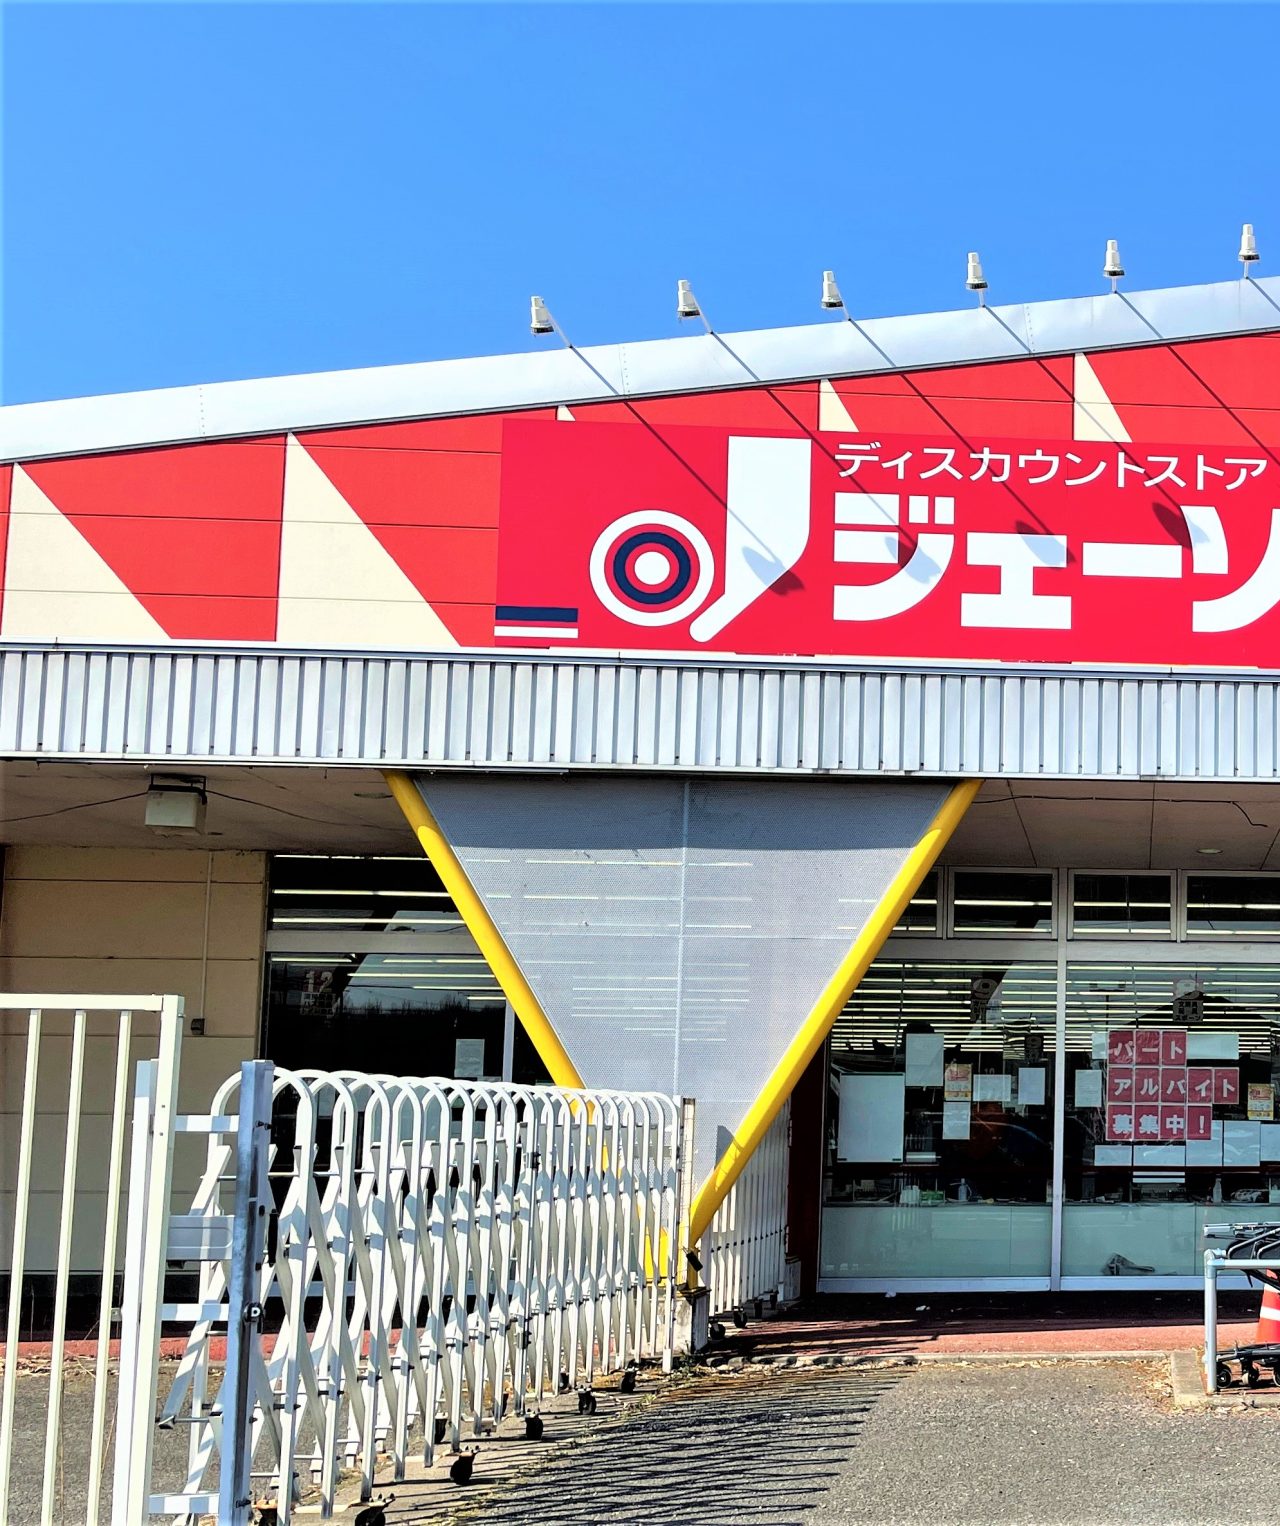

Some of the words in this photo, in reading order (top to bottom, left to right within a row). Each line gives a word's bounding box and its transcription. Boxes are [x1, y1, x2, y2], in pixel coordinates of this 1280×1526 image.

[835, 441, 1268, 491] ディスカウントストア
[1113, 1040, 1183, 1060] パート
[1114, 1078, 1236, 1098] アルバイト
